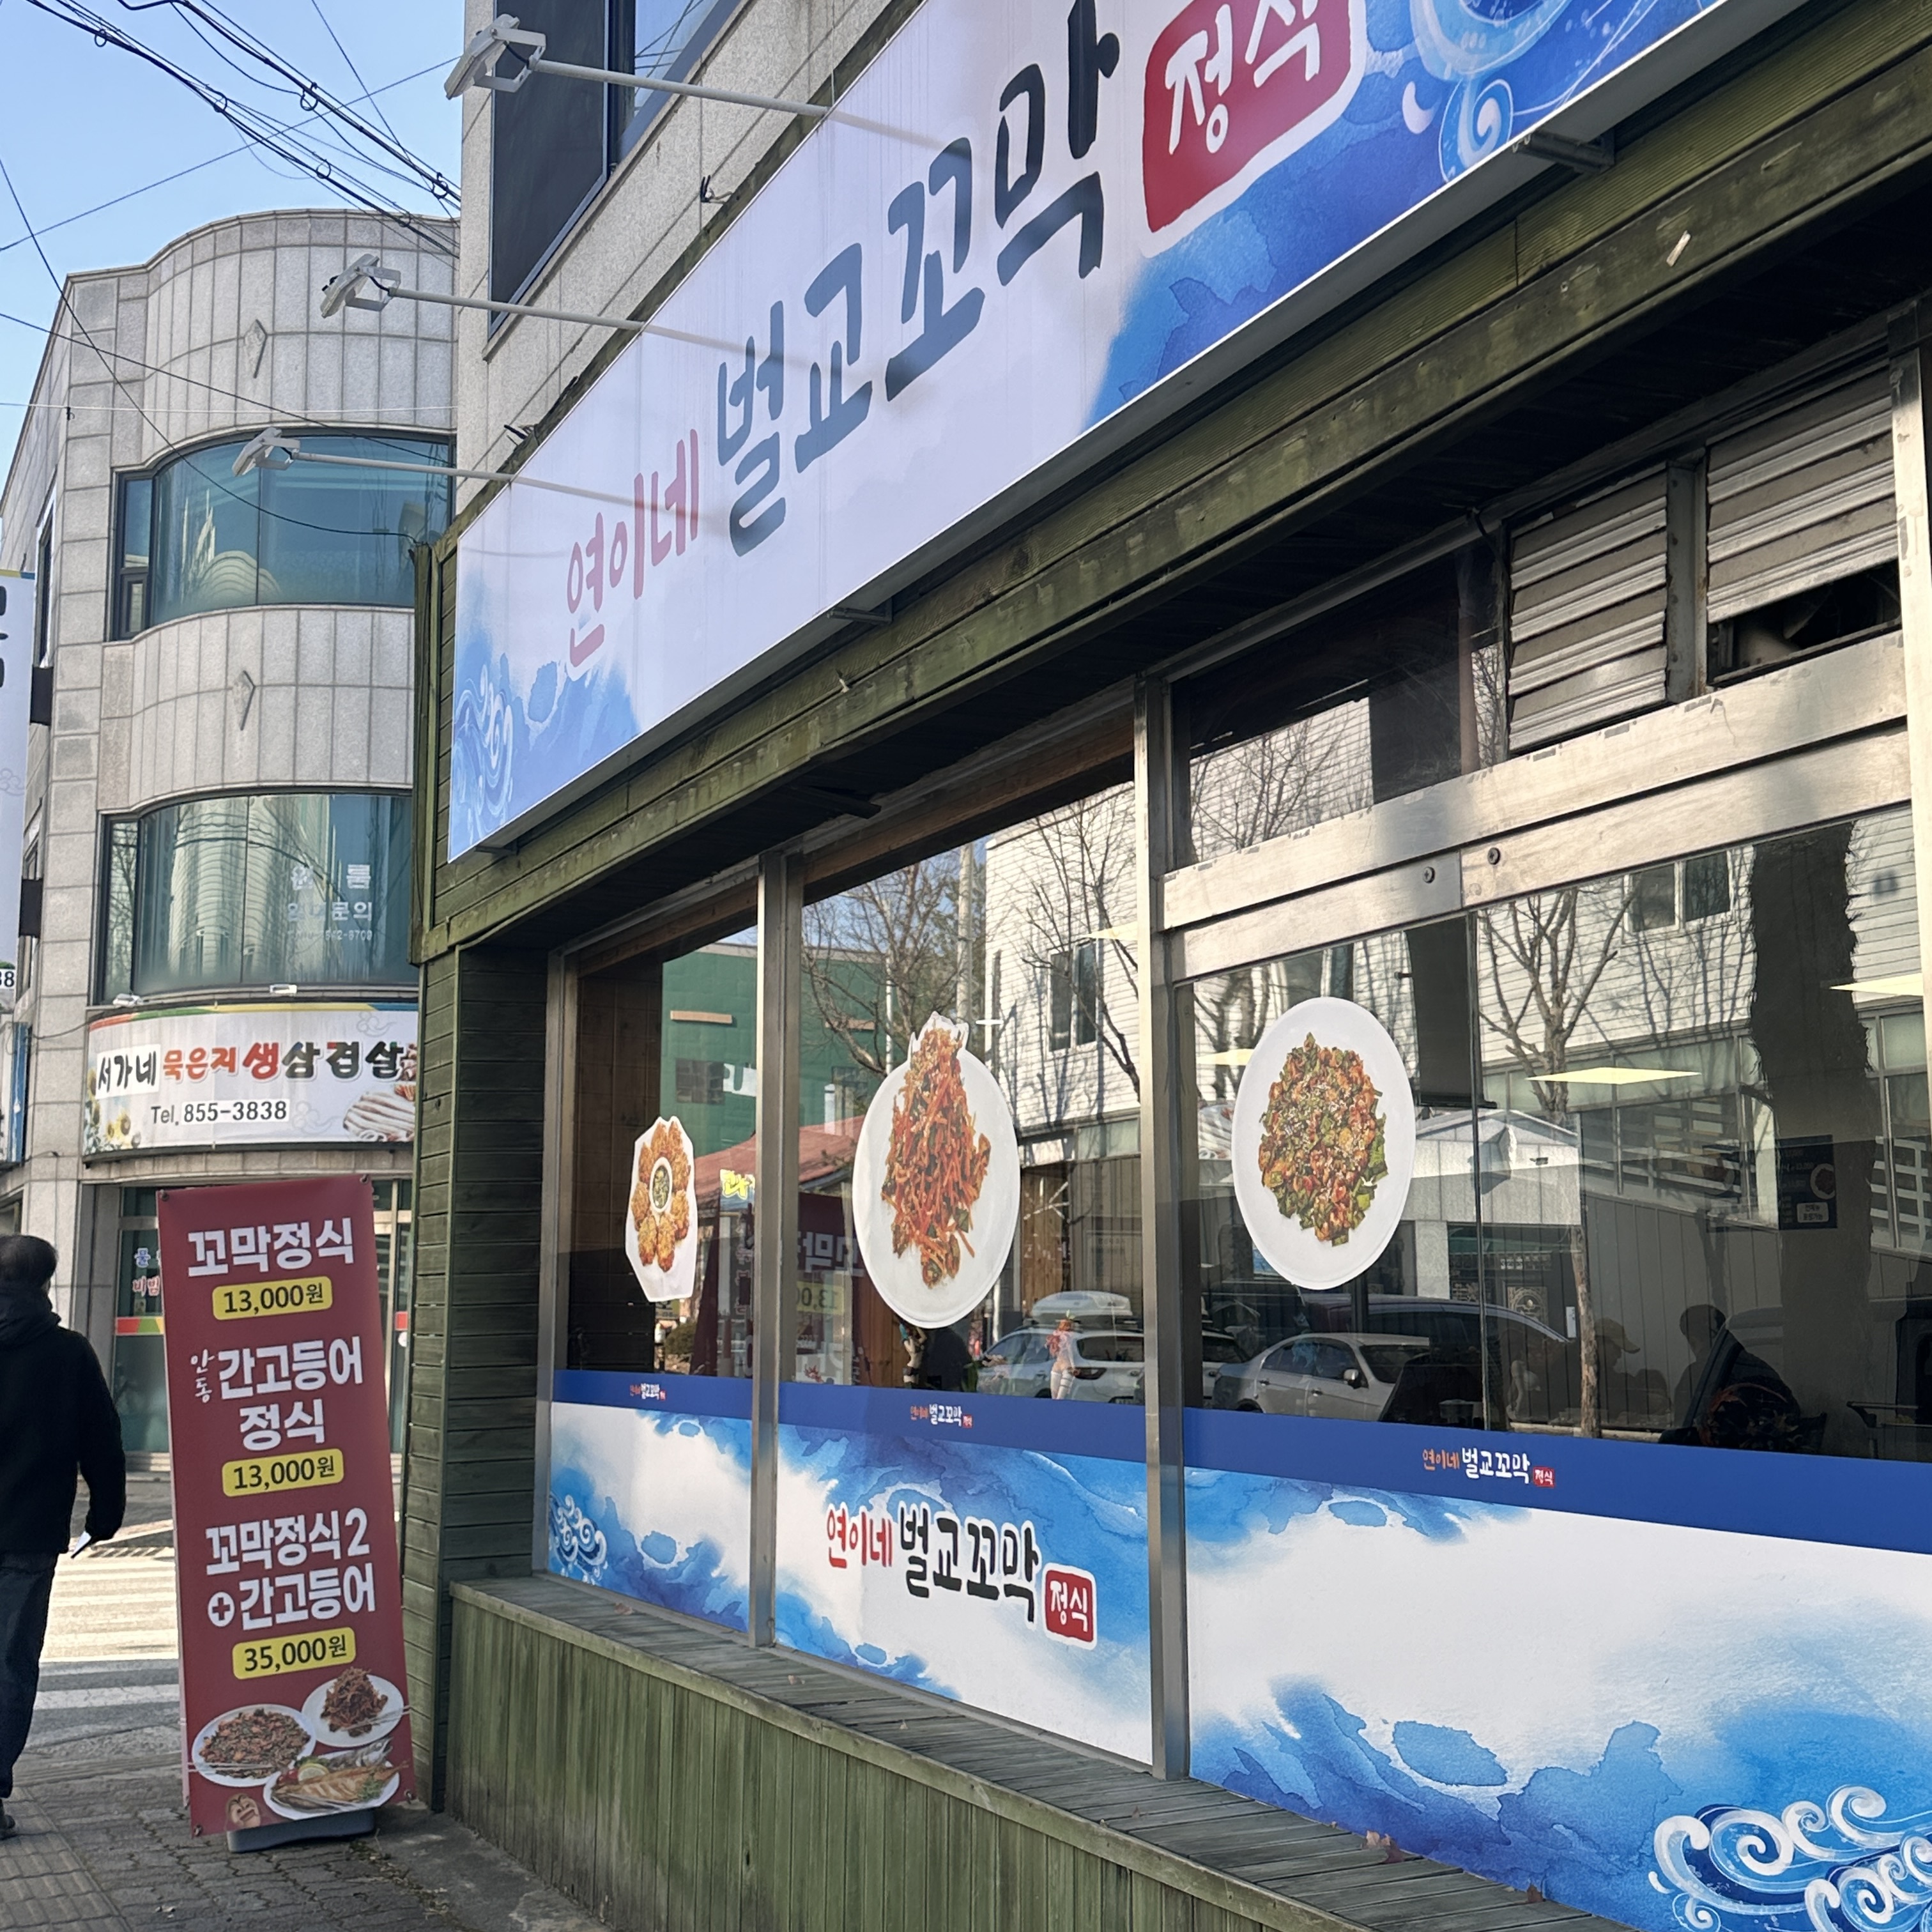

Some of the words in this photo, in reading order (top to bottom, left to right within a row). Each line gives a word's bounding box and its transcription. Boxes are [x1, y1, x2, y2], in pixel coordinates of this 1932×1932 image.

[567, 428, 698, 667] 연이네
[716, 0, 1120, 556] 벌교꼬막
[0, 971, 14, 986] 8
[98, 1050, 158, 1092] 서가네
[151, 1105, 179, 1126] Tel.
[184, 1101, 287, 1123] 855-3838
[188, 1217, 354, 1277] 꼬막정식
[224, 1283, 323, 1314] 13,000원
[190, 1349, 215, 1403] 안동
[218, 1336, 363, 1400] 간고등어
[240, 1399, 325, 1451] 정식
[929, 1403, 962, 1427] 벌교꼬막
[234, 1456, 335, 1490] 13,000원
[1422, 1448, 1459, 1471] 연이네
[1462, 1447, 1530, 1484] 벌교꼬막
[1535, 1469, 1554, 1485] 정식
[827, 1507, 893, 1568] 연이네
[900, 1506, 1039, 1623] 벌교꼬막
[1050, 1581, 1089, 1632] 정식
[240, 1563, 376, 1630] 간고등어
[244, 1634, 348, 1672] 35,000원
